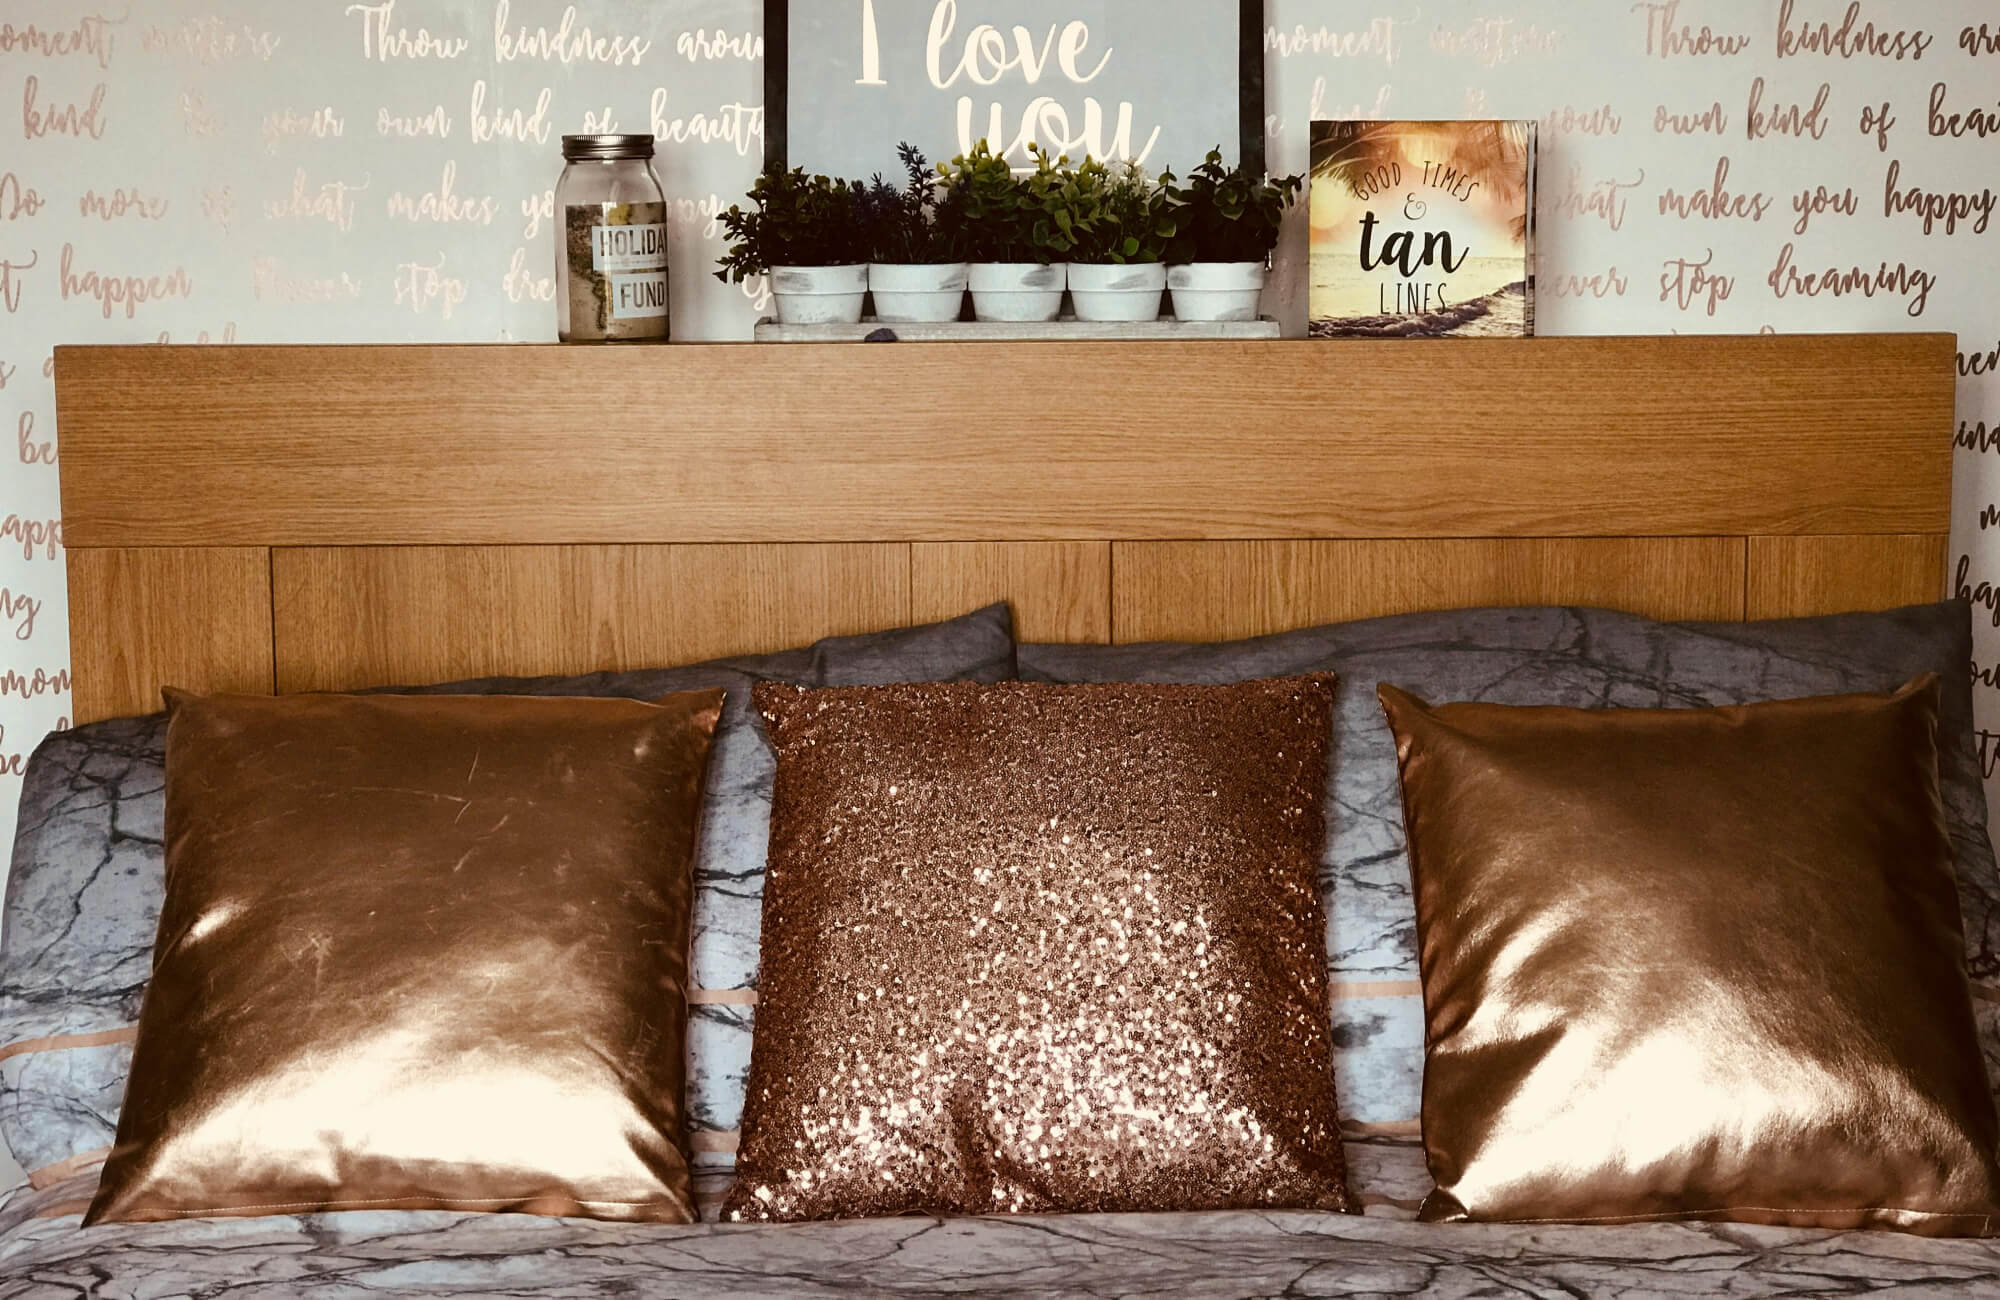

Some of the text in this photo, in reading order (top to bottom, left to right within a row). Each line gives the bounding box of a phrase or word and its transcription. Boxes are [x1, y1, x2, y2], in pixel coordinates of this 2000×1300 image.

[345, 2, 469, 62] Throw
[494, 2, 650, 65] kindness
[926, 0, 1113, 89] love
[1631, 0, 1750, 58] Throw
[1777, 0, 1933, 60] kindness
[23, 75, 107, 140] kind
[376, 104, 452, 138] own
[470, 80, 552, 144] kind
[956, 96, 1161, 170] you
[1655, 102, 1727, 135] own
[1747, 77, 1830, 140] kind
[1860, 102, 1896, 152] of
[80, 189, 167, 220] more
[387, 160, 499, 226] makes
[1353, 160, 1480, 202] GOOD TIMES
[1404, 192, 1427, 220] &
[1658, 156, 1773, 222] makes
[1793, 186, 1857, 235] you
[1884, 159, 1997, 235] happy
[600, 227, 667, 257] HOLIDA
[1359, 210, 1470, 278] tan
[60, 243, 192, 319] happen
[393, 250, 467, 319] stop
[620, 281, 665, 309] FUND
[1380, 282, 1447, 315] LINES
[1660, 248, 1734, 316] stop
[1768, 242, 1936, 317] dreaming
